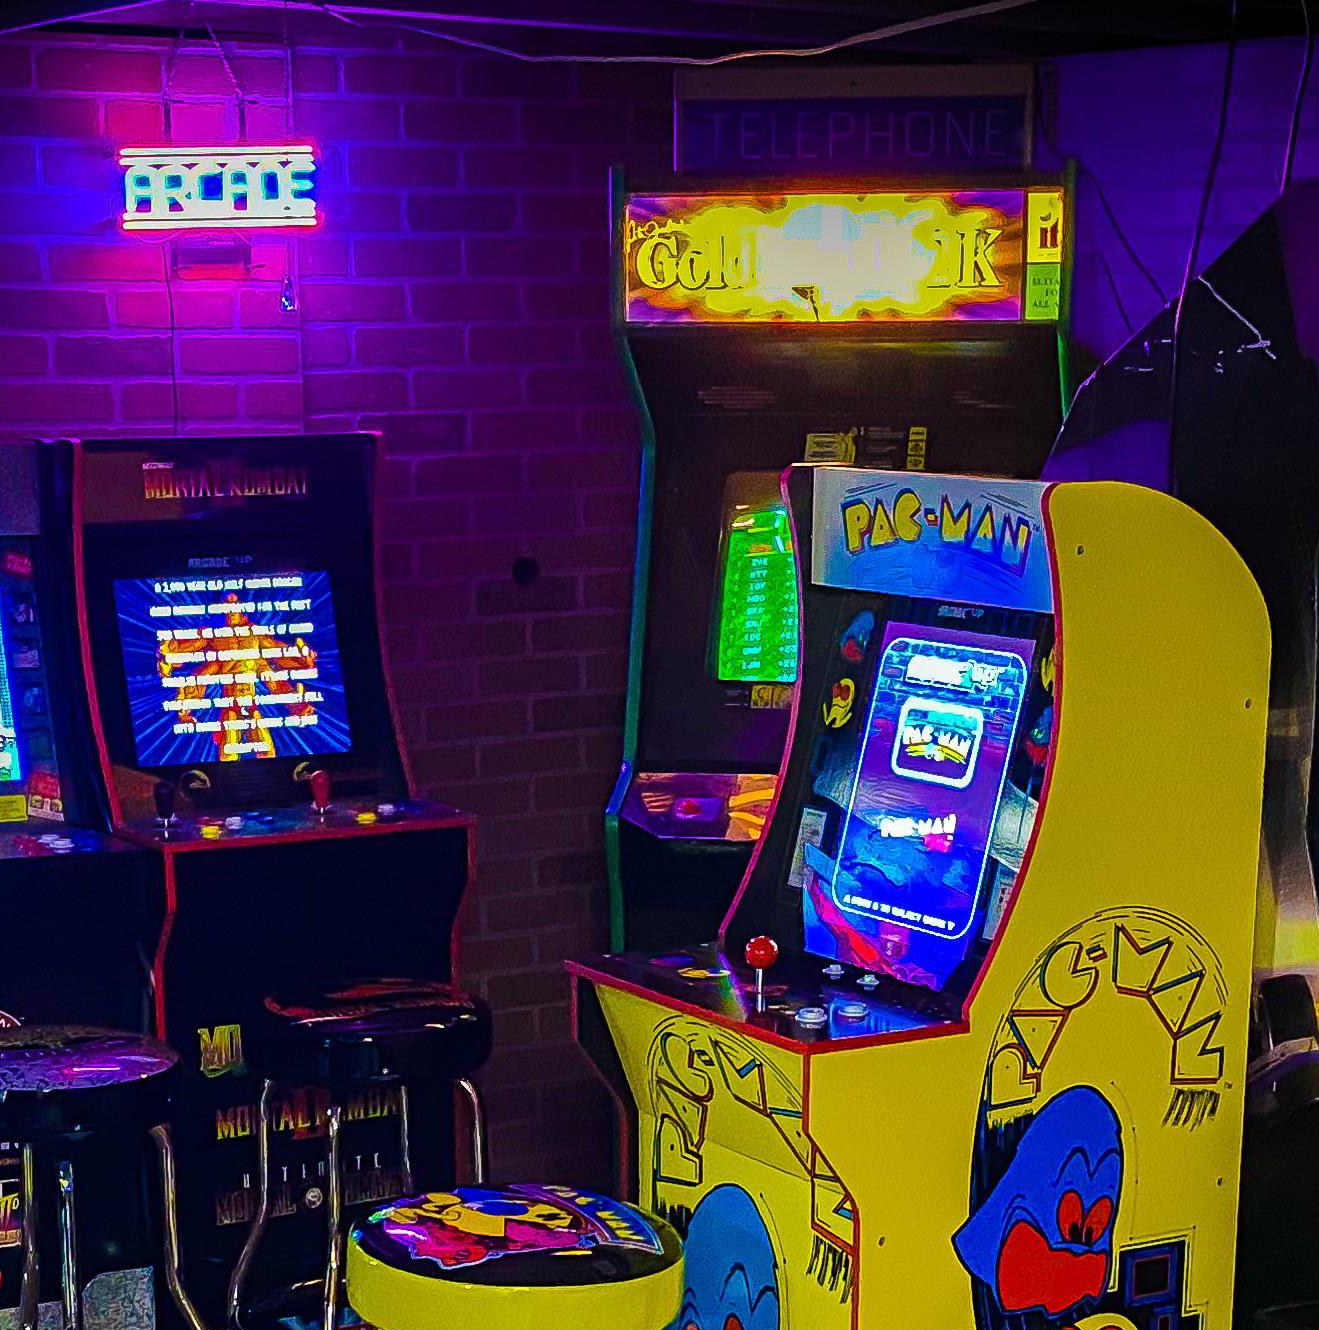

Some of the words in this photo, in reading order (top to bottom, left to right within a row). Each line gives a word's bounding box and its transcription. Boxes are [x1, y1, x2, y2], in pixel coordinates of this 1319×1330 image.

[703, 107, 1010, 161] TELEPHONE
[124, 164, 317, 216] ARCADE
[840, 487, 1033, 579] PAC-MAN
